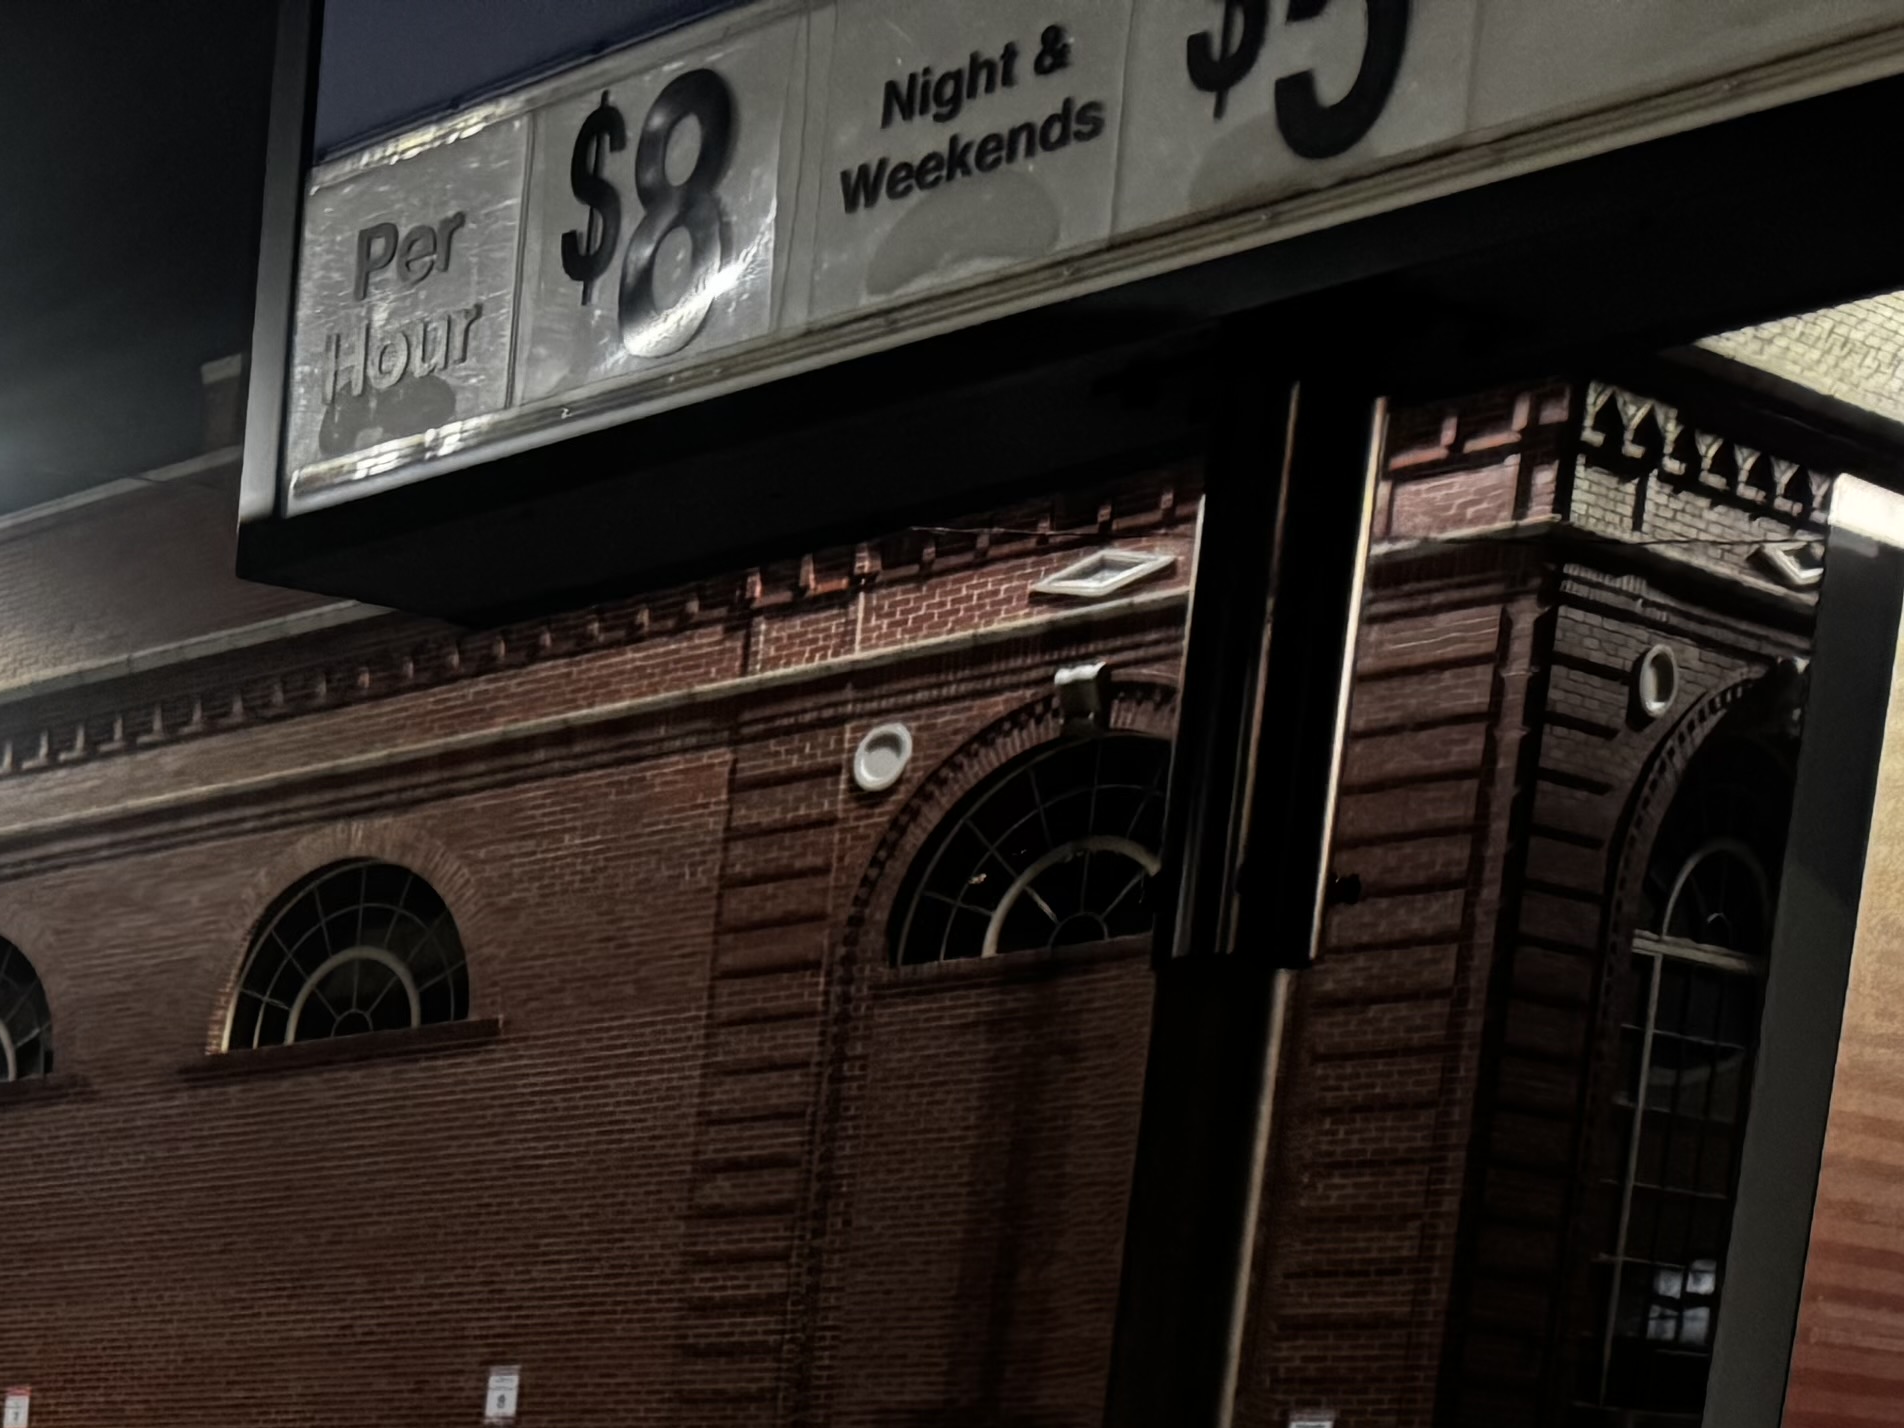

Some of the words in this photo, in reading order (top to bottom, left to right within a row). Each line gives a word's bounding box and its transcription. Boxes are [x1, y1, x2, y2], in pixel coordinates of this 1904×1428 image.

[881, 39, 1018, 129] Night
[1033, 23, 1074, 77] &
[840, 97, 1107, 214] Weekends
[353, 210, 466, 300] Per
[561, 66, 737, 358] $8
[323, 303, 483, 403] Hour
